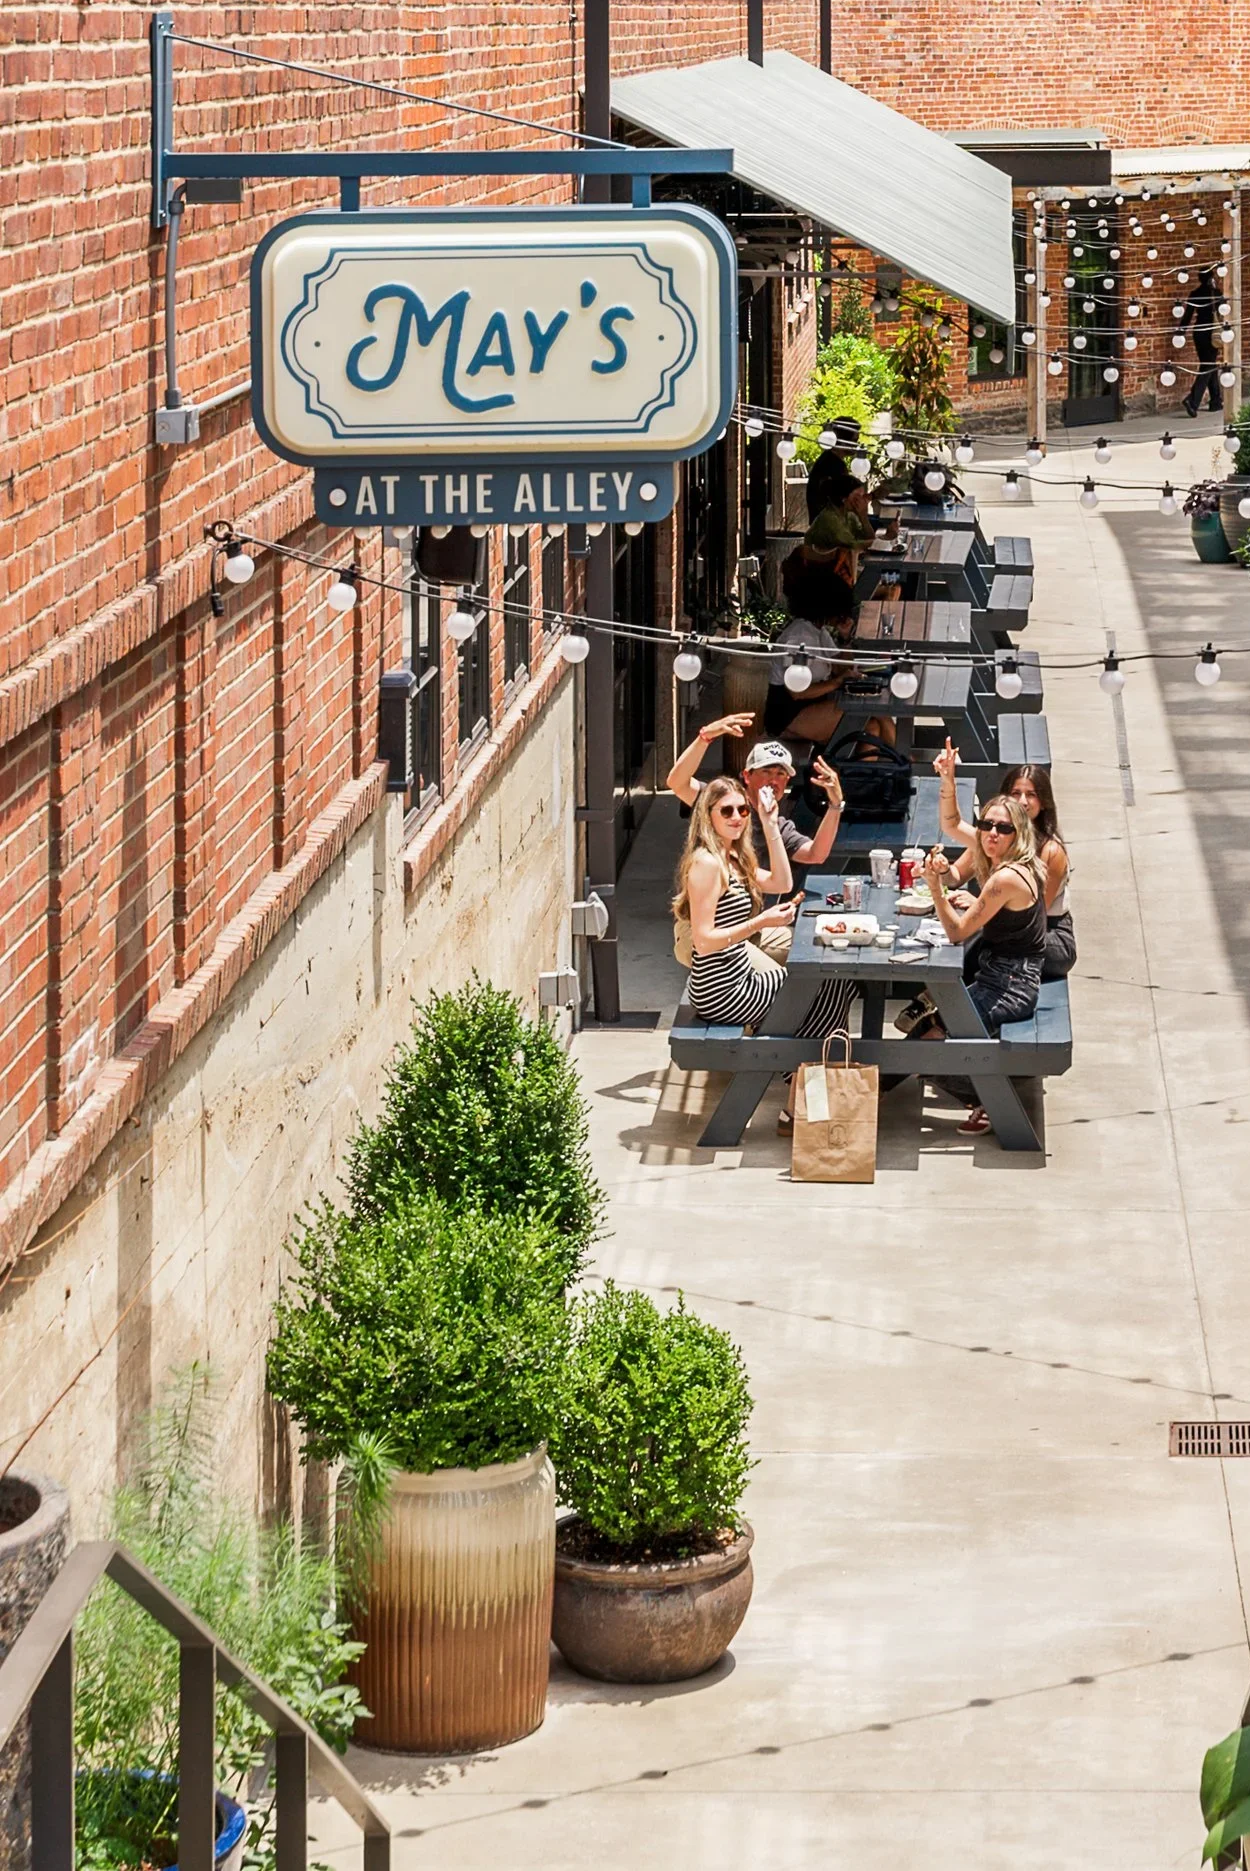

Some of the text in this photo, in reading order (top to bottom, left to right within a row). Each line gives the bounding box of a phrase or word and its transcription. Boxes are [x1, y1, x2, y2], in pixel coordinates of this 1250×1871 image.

[346, 281, 635, 414] MAY'S
[355, 471, 633, 515] AT THE ALLEY
